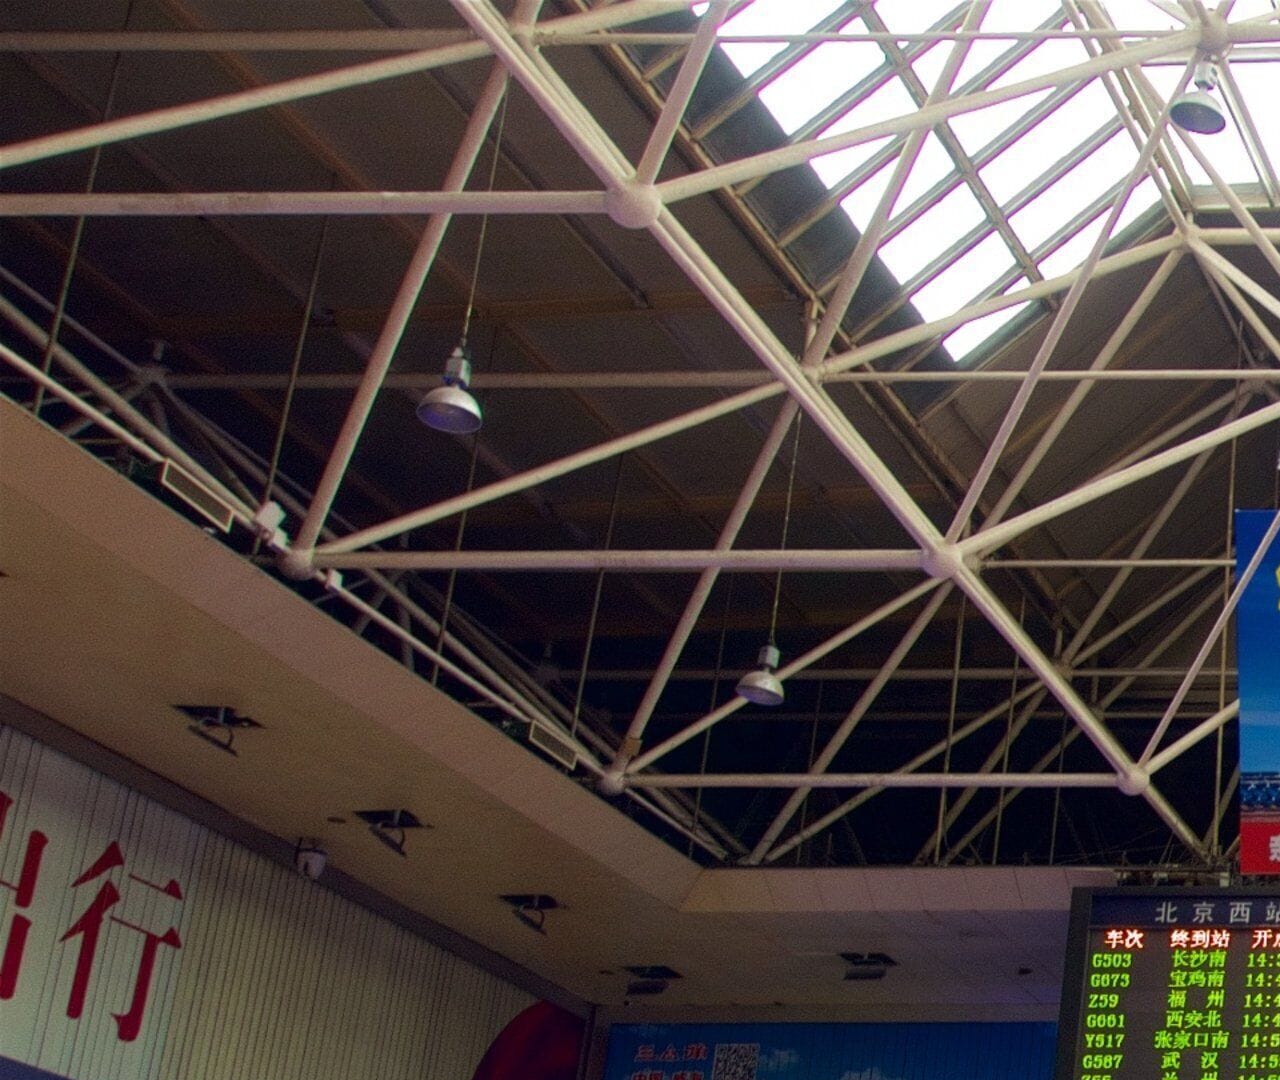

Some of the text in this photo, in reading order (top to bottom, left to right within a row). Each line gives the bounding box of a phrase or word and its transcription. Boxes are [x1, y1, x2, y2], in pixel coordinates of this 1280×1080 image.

[1104, 928, 1143, 948] 车次
[1170, 928, 1230, 948] 终到站
[1092, 952, 1132, 969] G503
[1172, 949, 1228, 969] 长沙南
[1084, 1033, 1125, 1049] Y517
[1154, 1029, 1230, 1050] 张家口南
